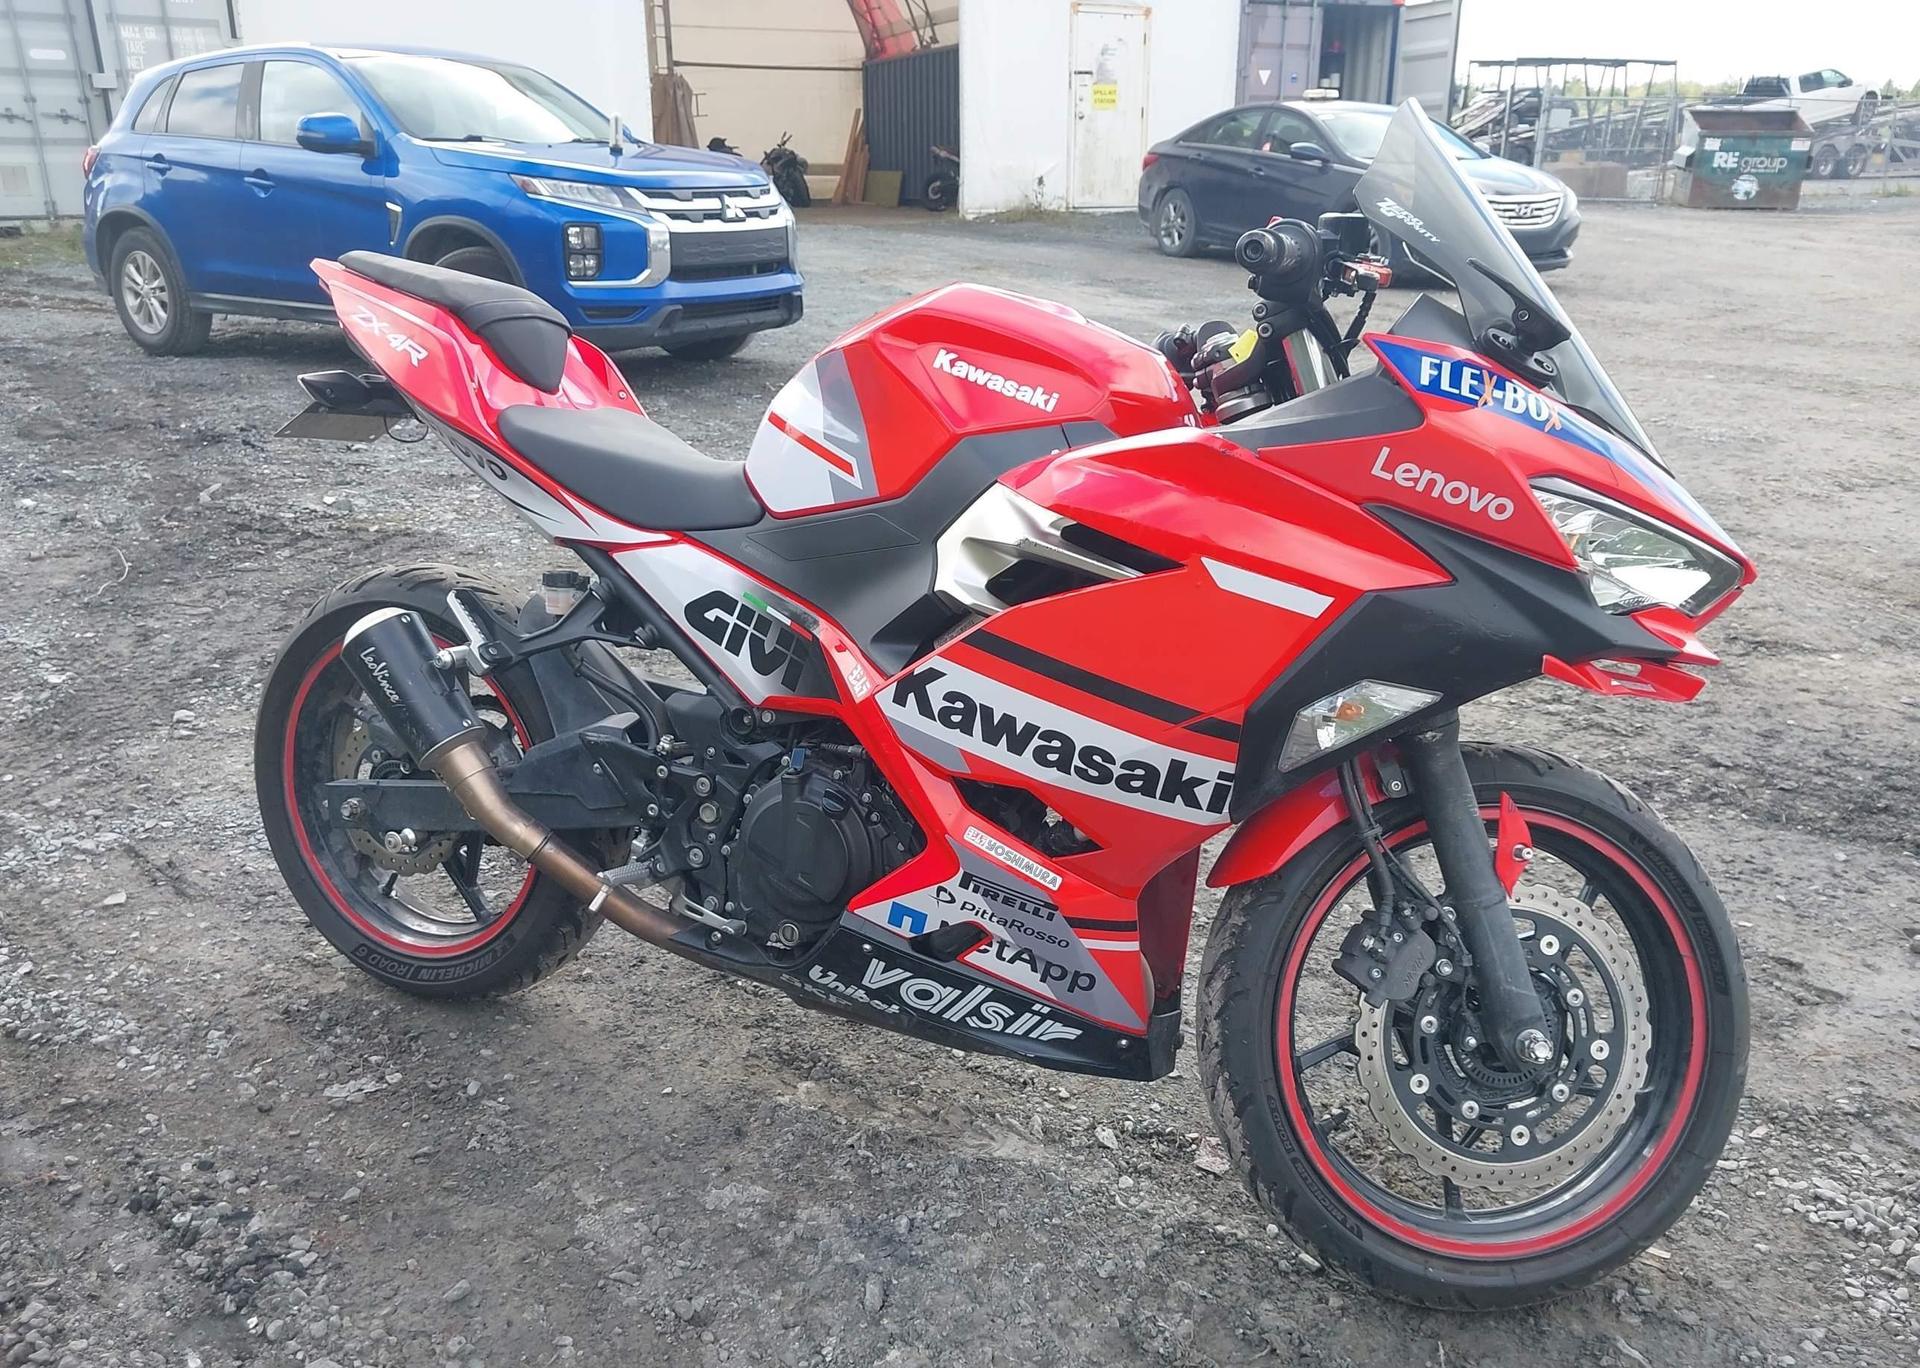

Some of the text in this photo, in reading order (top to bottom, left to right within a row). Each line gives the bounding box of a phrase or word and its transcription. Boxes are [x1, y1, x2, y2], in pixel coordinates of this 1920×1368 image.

[1741, 156, 1788, 173] group
[351, 305, 429, 368] ZX-4R
[933, 348, 1060, 413] Kawasaki
[1420, 356, 1562, 433] FLEX-BOX
[1371, 446, 1515, 521] Lenovo
[684, 590, 808, 693] GIVI
[892, 666, 1236, 815] Kawasaki
[985, 838, 1060, 889] YOSHIMURA
[958, 870, 1060, 922] PIRELLI
[960, 900, 1071, 949] PittaRosso
[367, 955, 410, 977] ROAD
[417, 950, 496, 981] MICHELIN
[809, 964, 900, 1014] Unibat
